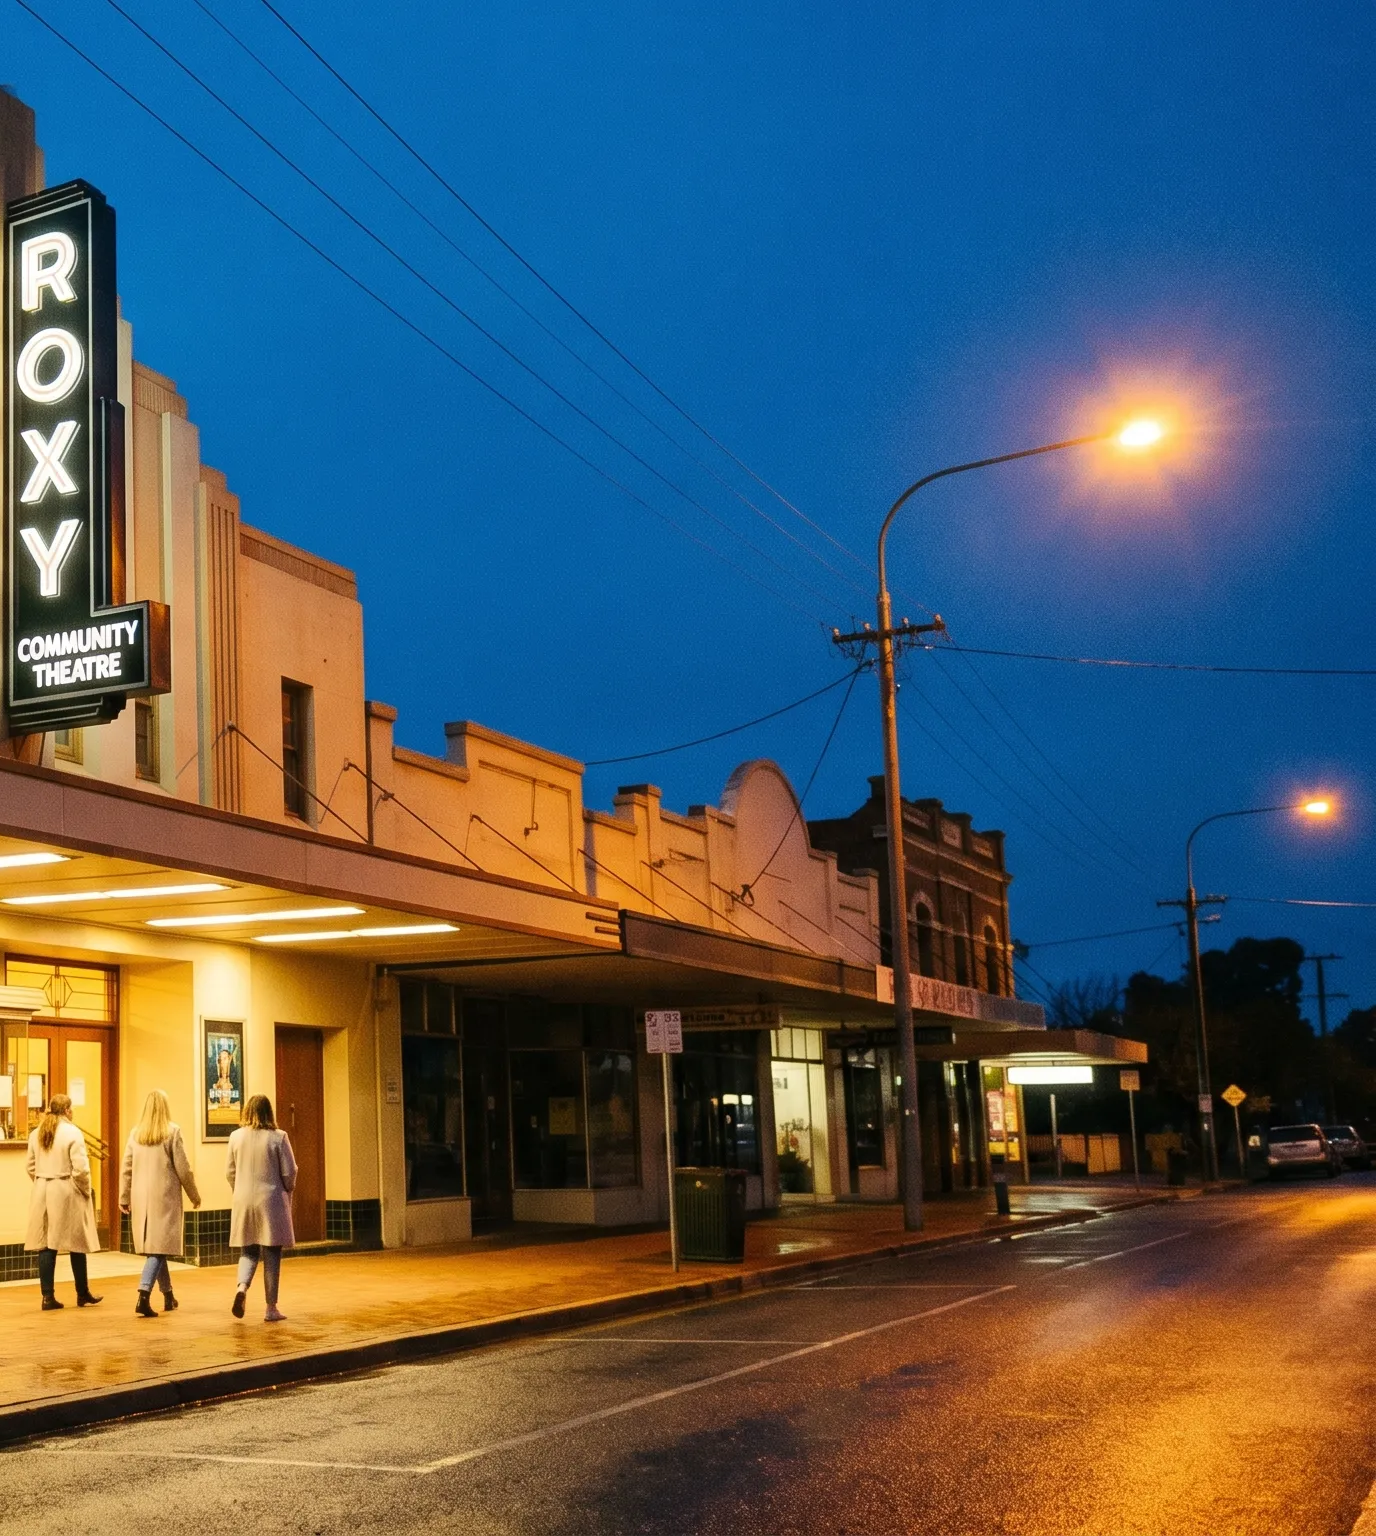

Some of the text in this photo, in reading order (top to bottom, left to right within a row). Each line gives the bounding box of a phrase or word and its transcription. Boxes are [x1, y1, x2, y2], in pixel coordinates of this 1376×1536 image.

[17, 231, 85, 597] ROXY
[17, 619, 139, 663] COMMUNITY
[32, 652, 122, 688] THEATRE
